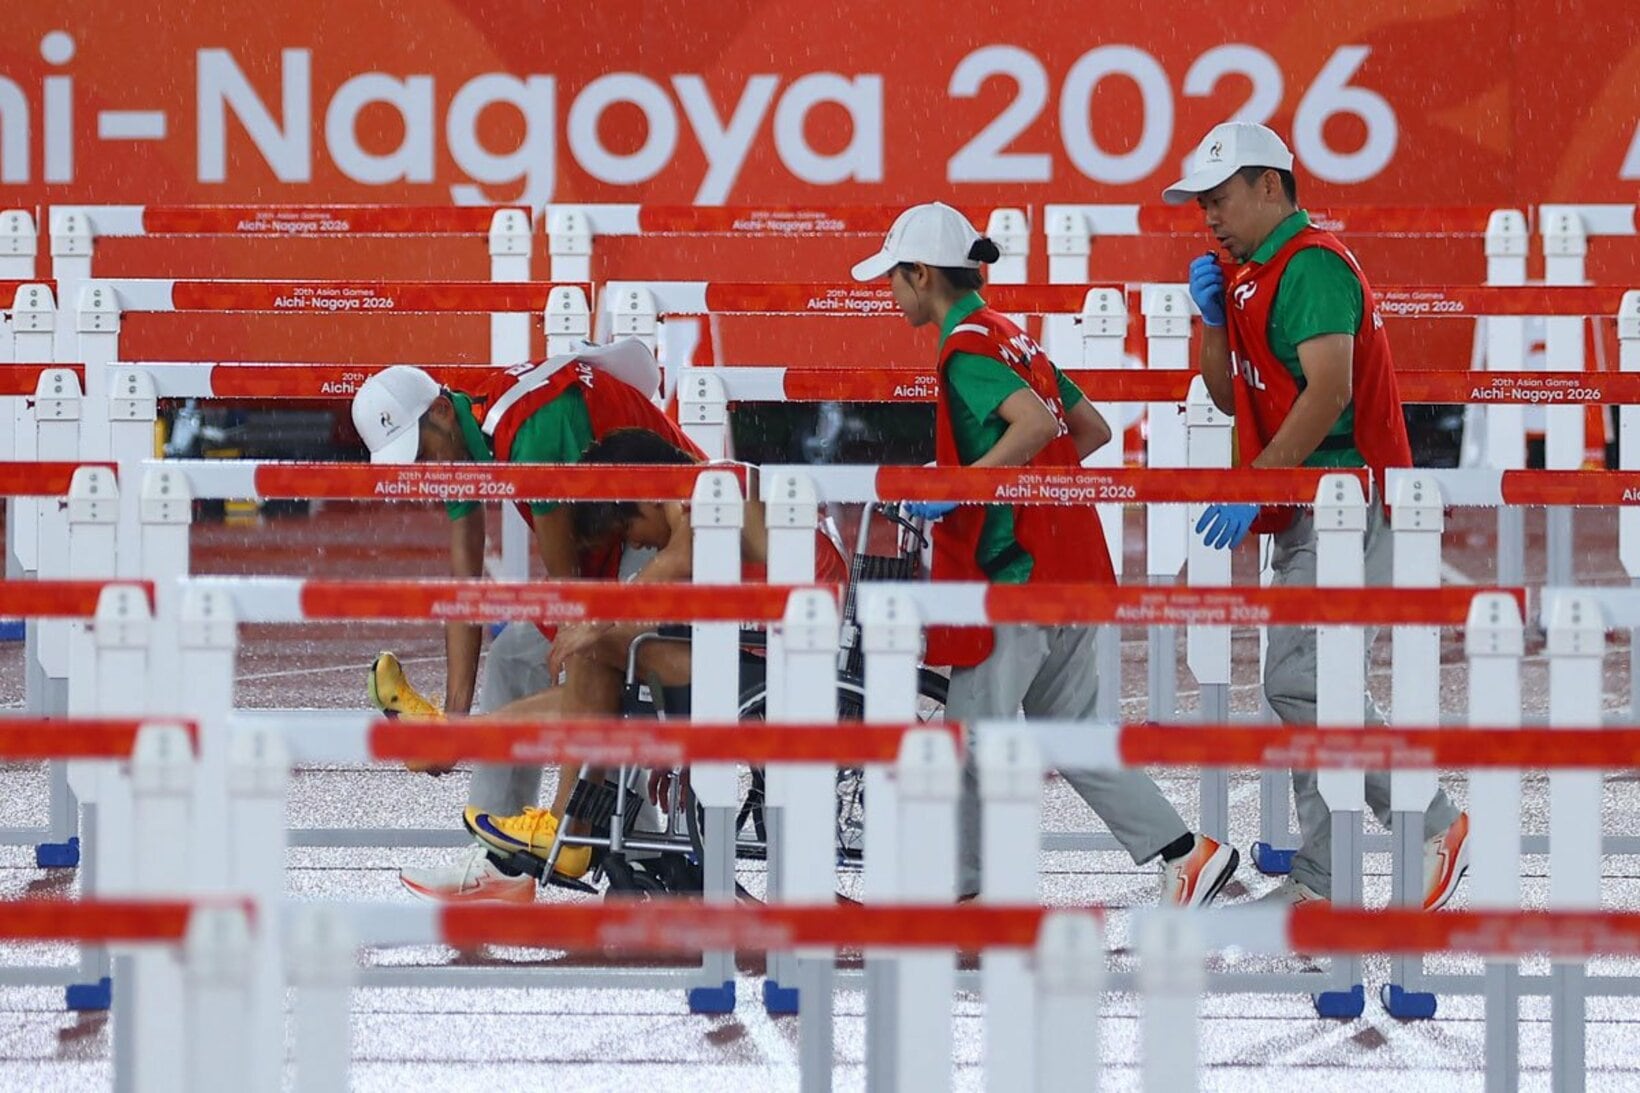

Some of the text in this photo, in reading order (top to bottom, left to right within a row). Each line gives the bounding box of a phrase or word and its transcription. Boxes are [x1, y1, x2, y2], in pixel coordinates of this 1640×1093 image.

[946, 43, 1399, 184] 2026
[236, 220, 349, 234] Aichi-Nagoya 2026
[293, 287, 375, 296] 20th Asian Games
[826, 289, 847, 298] 20th
[849, 289, 874, 298] Asian
[1411, 291, 1445, 300] Games
[274, 296, 394, 311] Aichi-Nagoya 2026
[807, 297, 893, 312] Aichi-Nagoya
[1432, 301, 1465, 312] 2026
[341, 372, 365, 381] 20th
[914, 375, 937, 384] 20th
[1491, 378, 1579, 387] 20th Asian Games
[1471, 387, 1601, 402] Aichi-Nagoya 2026
[398, 471, 492, 481] 20th Asian Games
[1017, 475, 1113, 484] 20th Asian Games
[374, 480, 515, 498] Aichi-Nagoya 2026
[995, 484, 1137, 501] Aichi-Nagoya 2026
